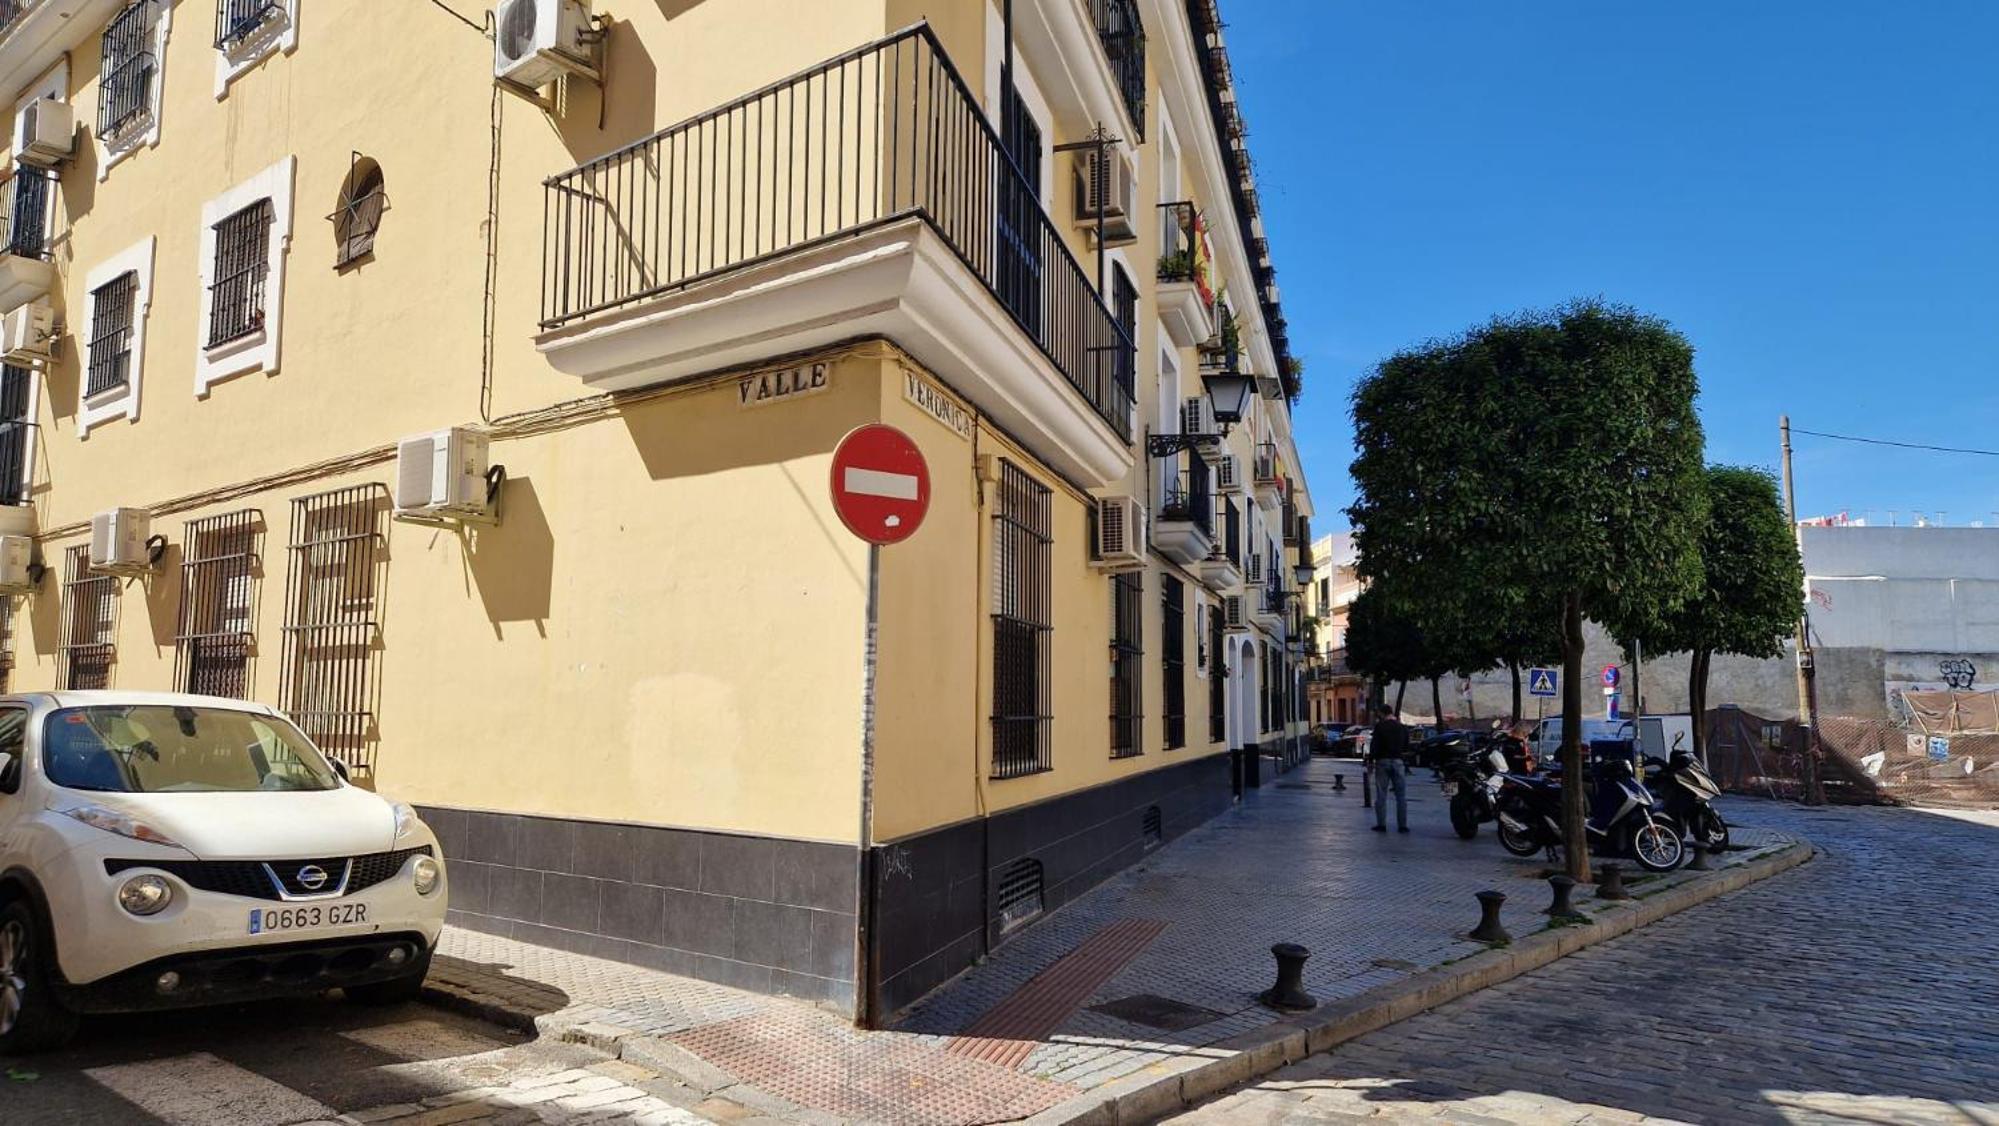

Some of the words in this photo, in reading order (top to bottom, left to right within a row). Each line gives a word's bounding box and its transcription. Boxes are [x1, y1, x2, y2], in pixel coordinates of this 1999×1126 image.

[739, 362, 826, 403] VALLE
[906, 372, 970, 437] VERONICA
[265, 907, 321, 929] 0663
[328, 903, 367, 924] GZR
